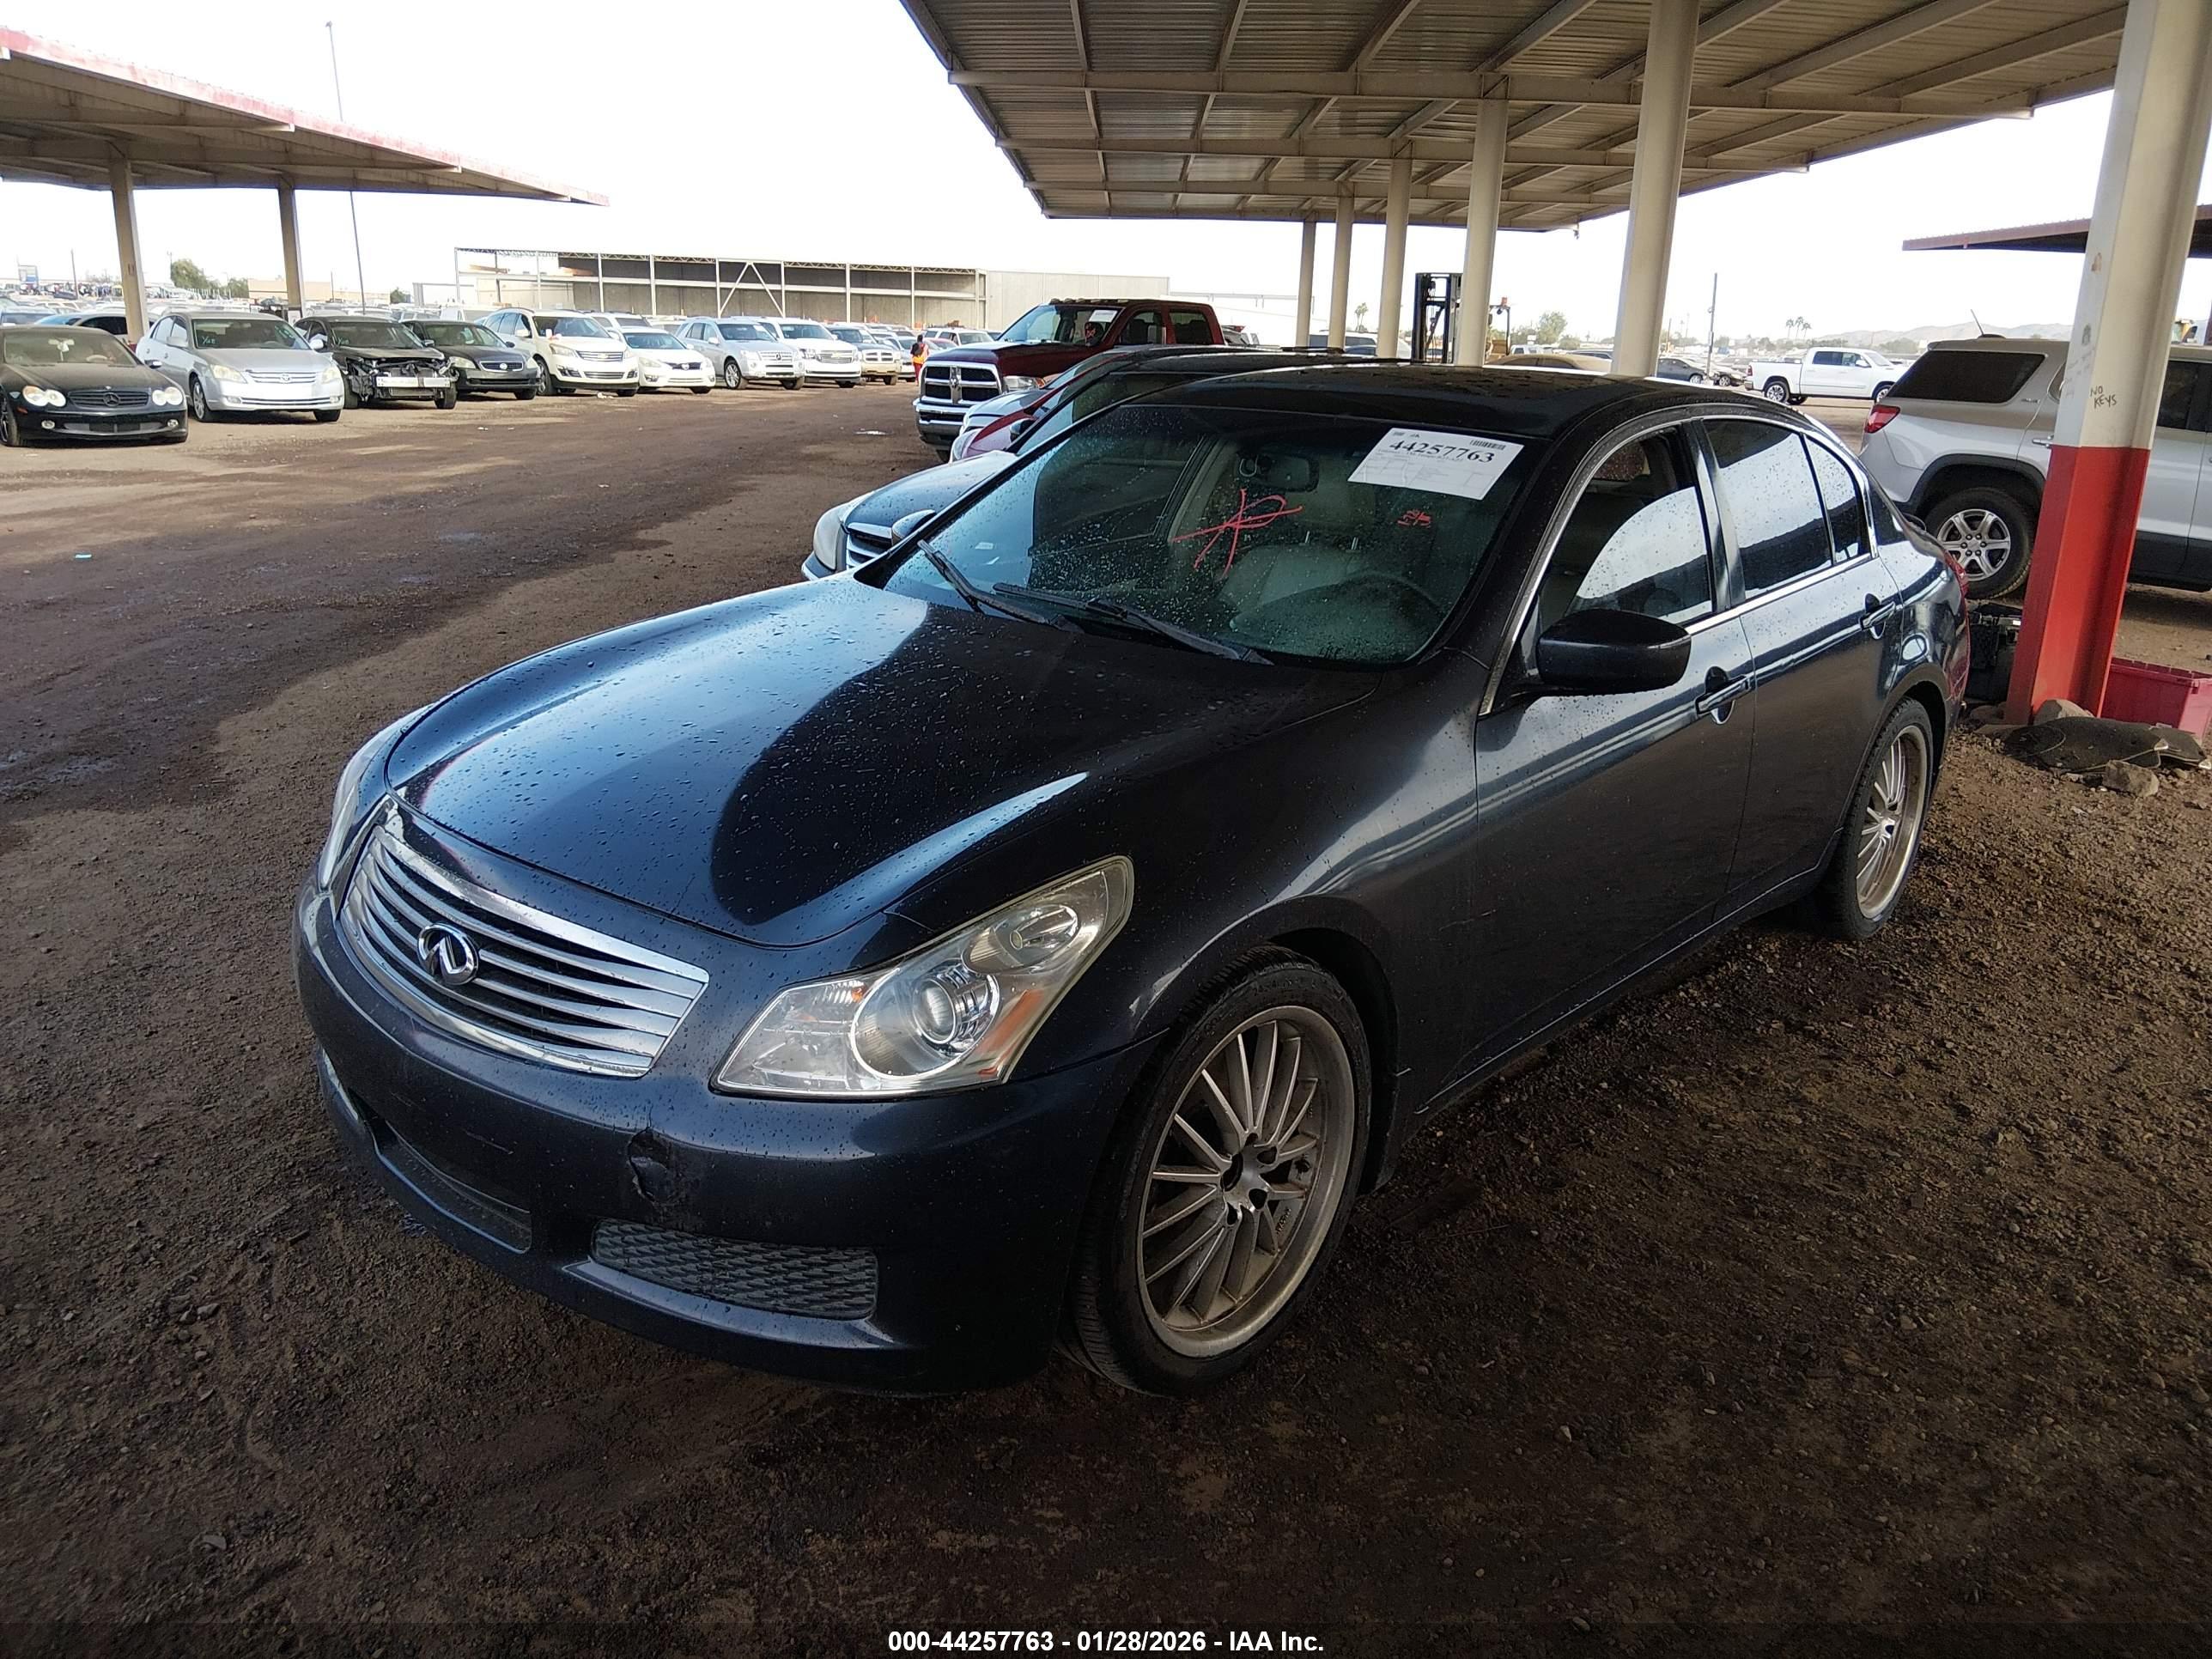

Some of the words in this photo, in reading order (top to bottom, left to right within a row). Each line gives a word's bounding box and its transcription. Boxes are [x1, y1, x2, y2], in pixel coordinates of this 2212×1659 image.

[2090, 386, 2103, 397] NO
[2094, 394, 2118, 409] KEYS
[1389, 441, 1495, 463] 44257763
